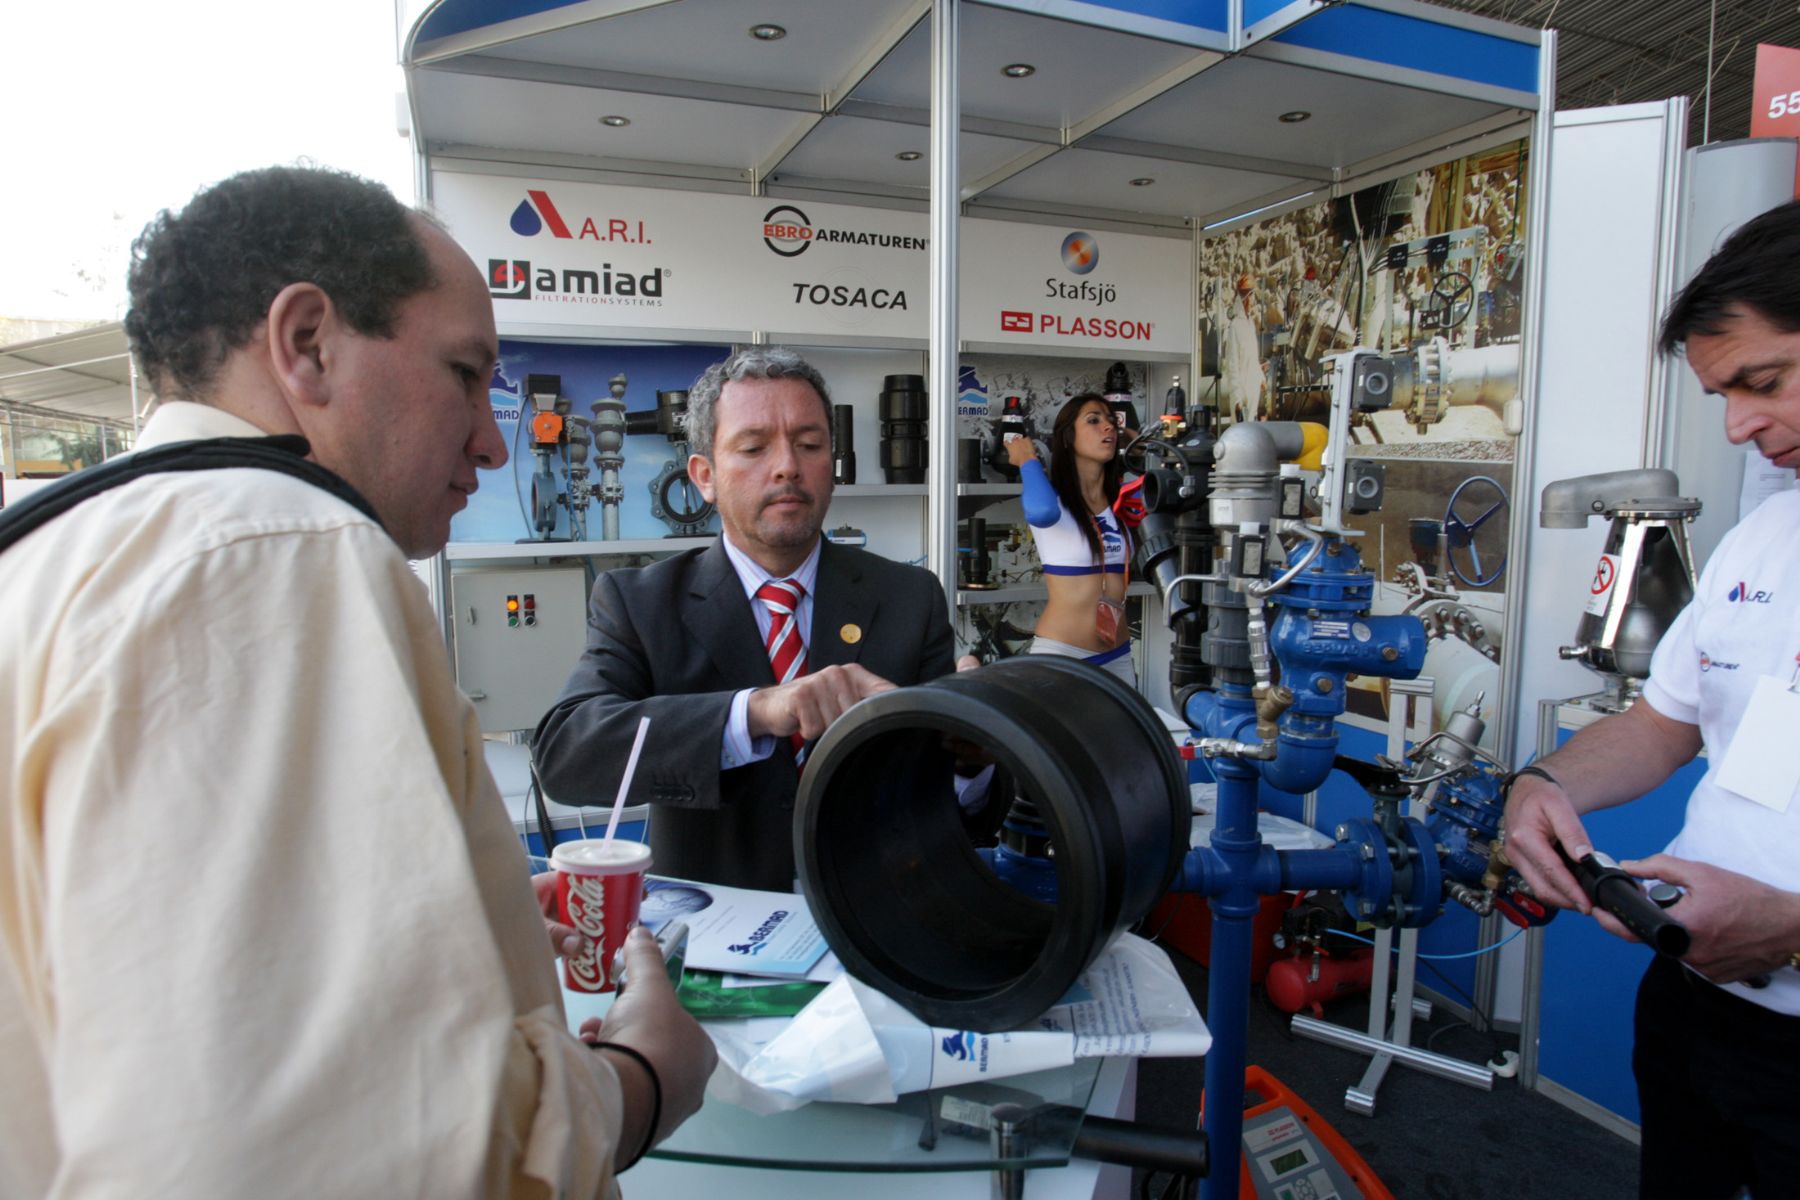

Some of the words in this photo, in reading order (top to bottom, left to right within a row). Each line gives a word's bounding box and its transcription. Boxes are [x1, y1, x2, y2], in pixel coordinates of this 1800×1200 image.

[578, 216, 652, 245] A.R.I.
[763, 224, 813, 240] EBRO
[815, 229, 926, 251] ARMATUREN
[535, 263, 662, 298] amiad
[1045, 278, 1117, 307] Stafsjö
[792, 283, 908, 311] TOSACA
[1040, 314, 1151, 341] PLASSON
[958, 406, 989, 416] ERMAD
